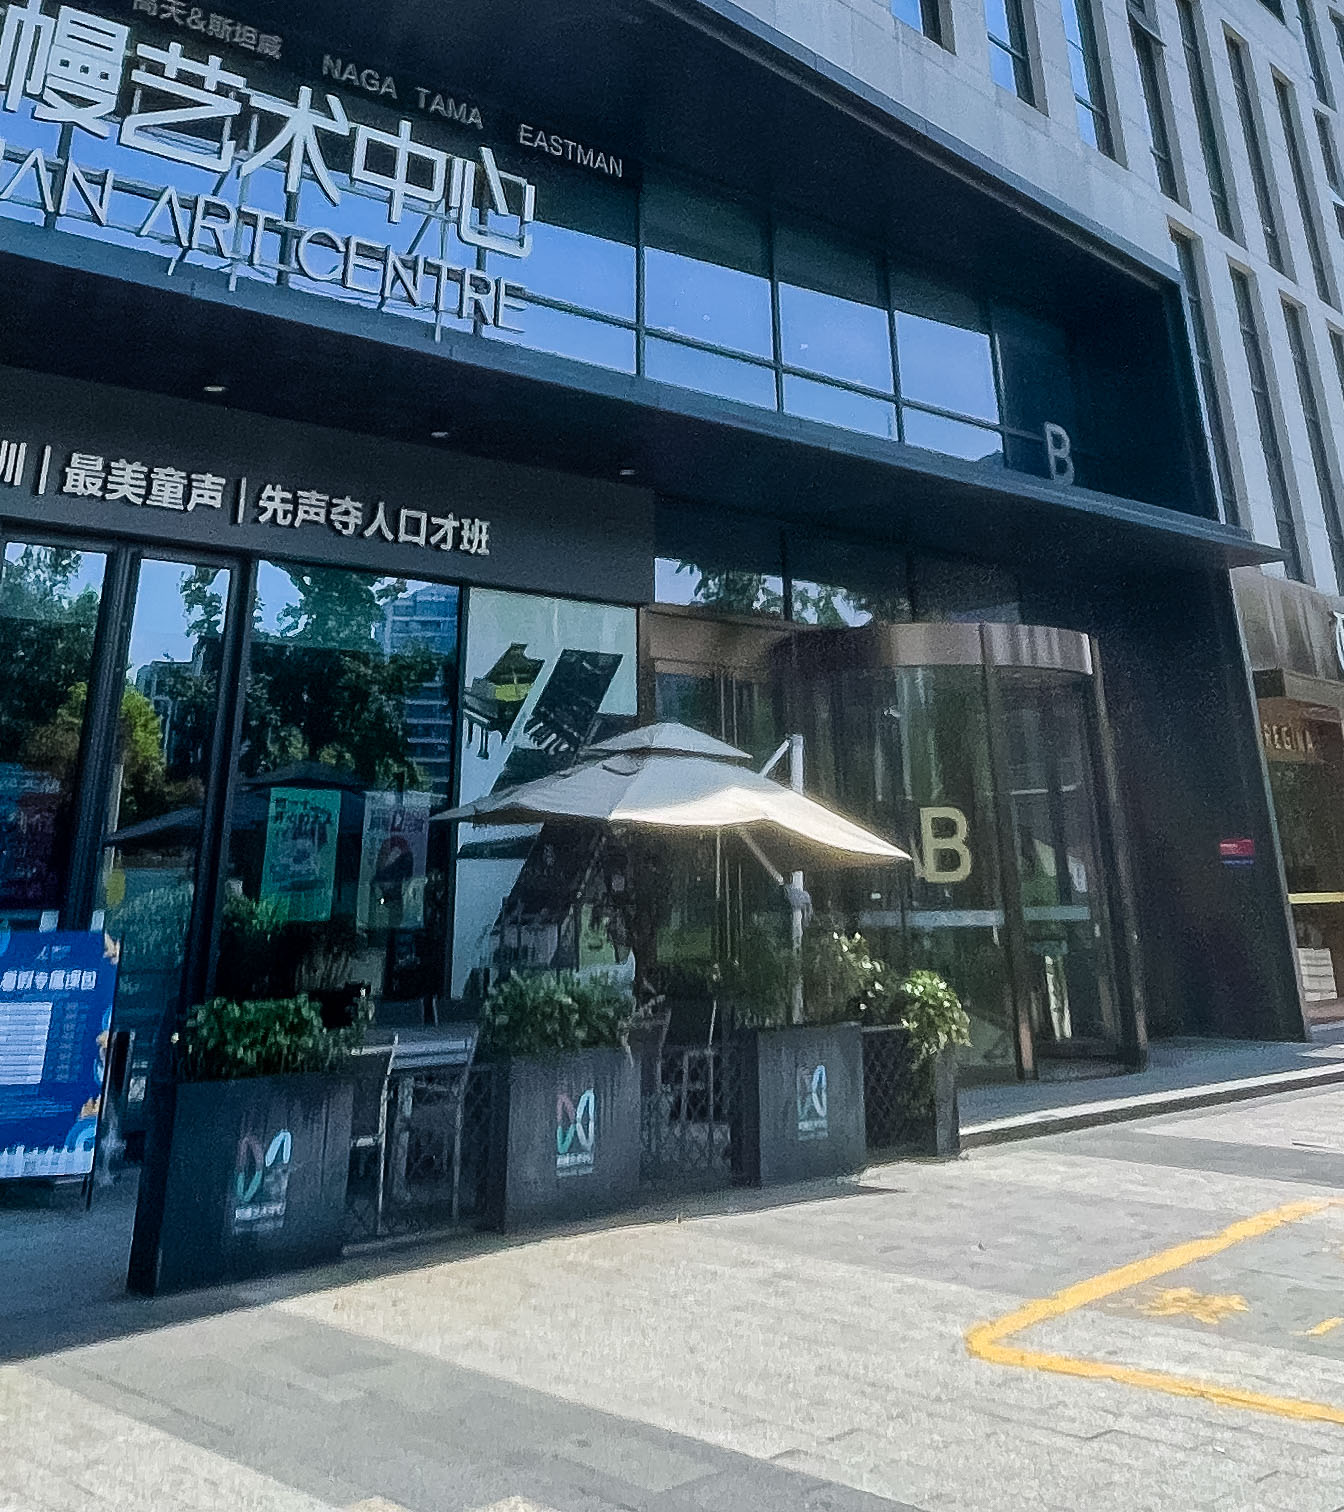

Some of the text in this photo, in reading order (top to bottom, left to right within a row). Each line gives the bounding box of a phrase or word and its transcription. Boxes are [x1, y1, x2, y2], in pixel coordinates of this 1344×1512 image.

[322, 54, 484, 130] NAGA TAMA
[518, 123, 623, 179] EASTMAN
[140, 186, 276, 265] ART
[297, 227, 527, 333] CENTRE
[1043, 421, 1075, 486] B
[64, 453, 227, 514] 最美童声
[259, 484, 490, 556] 先声夺人口才班
[920, 807, 971, 883] B
